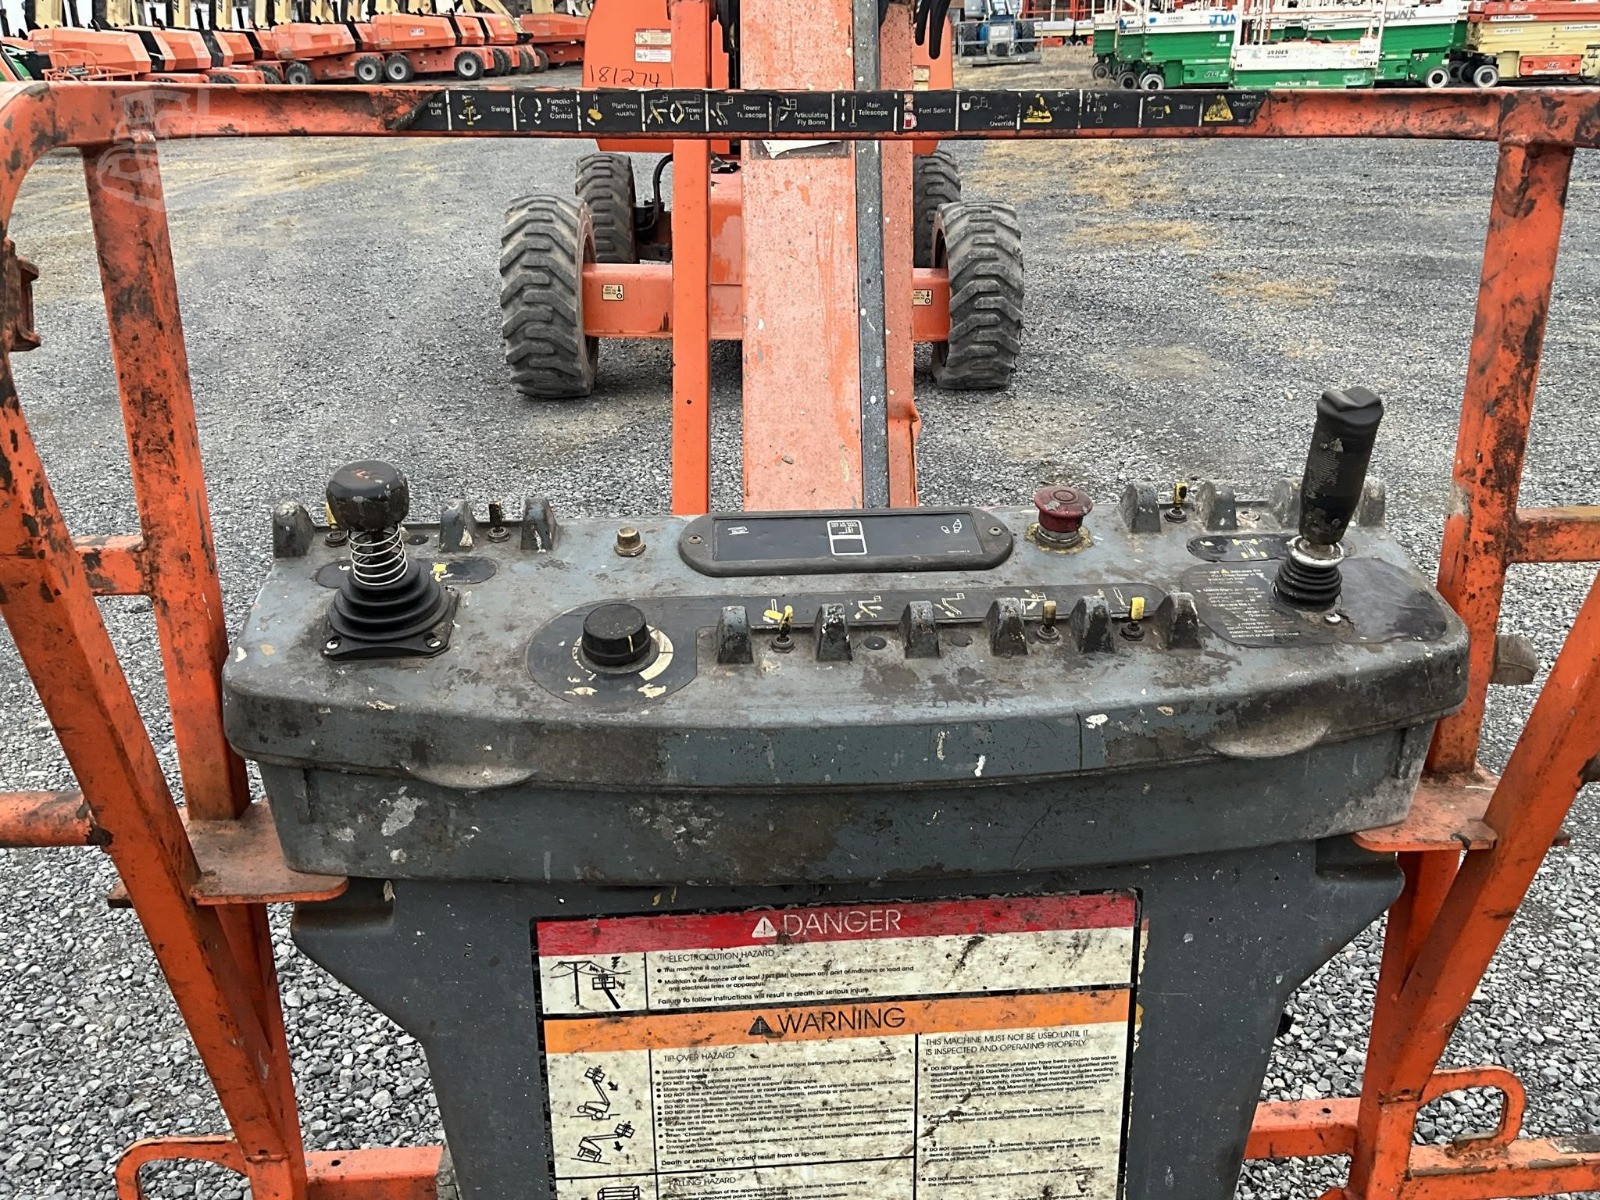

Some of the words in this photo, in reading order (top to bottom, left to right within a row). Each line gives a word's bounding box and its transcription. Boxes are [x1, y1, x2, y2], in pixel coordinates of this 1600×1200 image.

[589, 65, 662, 88] 181274
[490, 105, 510, 114] Swing
[685, 106, 703, 115] Tower
[742, 103, 761, 112] Tower
[918, 107, 932, 116] Fuel
[549, 112, 574, 121] Control
[736, 111, 767, 120] Teescope
[793, 111, 829, 121] Articulating
[858, 109, 889, 118] Telescope
[796, 119, 808, 127] Fly
[806, 119, 826, 127] Boom
[783, 909, 901, 936] DANGER
[669, 951, 740, 962] ELECTROCUTION
[741, 949, 775, 958] HAZARD
[676, 964, 703, 972] machine
[664, 978, 691, 986] Maintain
[698, 976, 728, 984] clearance
[790, 971, 816, 979] between
[817, 970, 828, 978] any
[830, 969, 842, 977] part
[851, 967, 878, 975] machine
[669, 985, 680, 993] any
[681, 984, 709, 992] electrical
[658, 997, 680, 1005] Failure
[692, 996, 711, 1004] follow
[713, 993, 752, 1002] instructions
[766, 991, 785, 999] result
[794, 990, 814, 998] death
[817, 989, 823, 997] or
[825, 988, 848, 996] serious
[777, 1007, 905, 1033] WARNING
[943, 1036, 981, 1045] MACHINE
[984, 1035, 1004, 1043] MUST
[1007, 1033, 1023, 1041] NOT
[1038, 1031, 1058, 1039] USED
[1060, 1030, 1080, 1038] UNTIL
[1083, 1029, 1088, 1037] IT
[934, 1046, 978, 1056] INSPECTED
[980, 1045, 997, 1053] AND
[1002, 1042, 1044, 1052] OPERATING
[664, 1054, 699, 1063] TIP-OVER
[702, 1052, 735, 1061] HAZARD
[717, 1156, 734, 1164] injury
[704, 1176, 737, 1185] HAZARD
